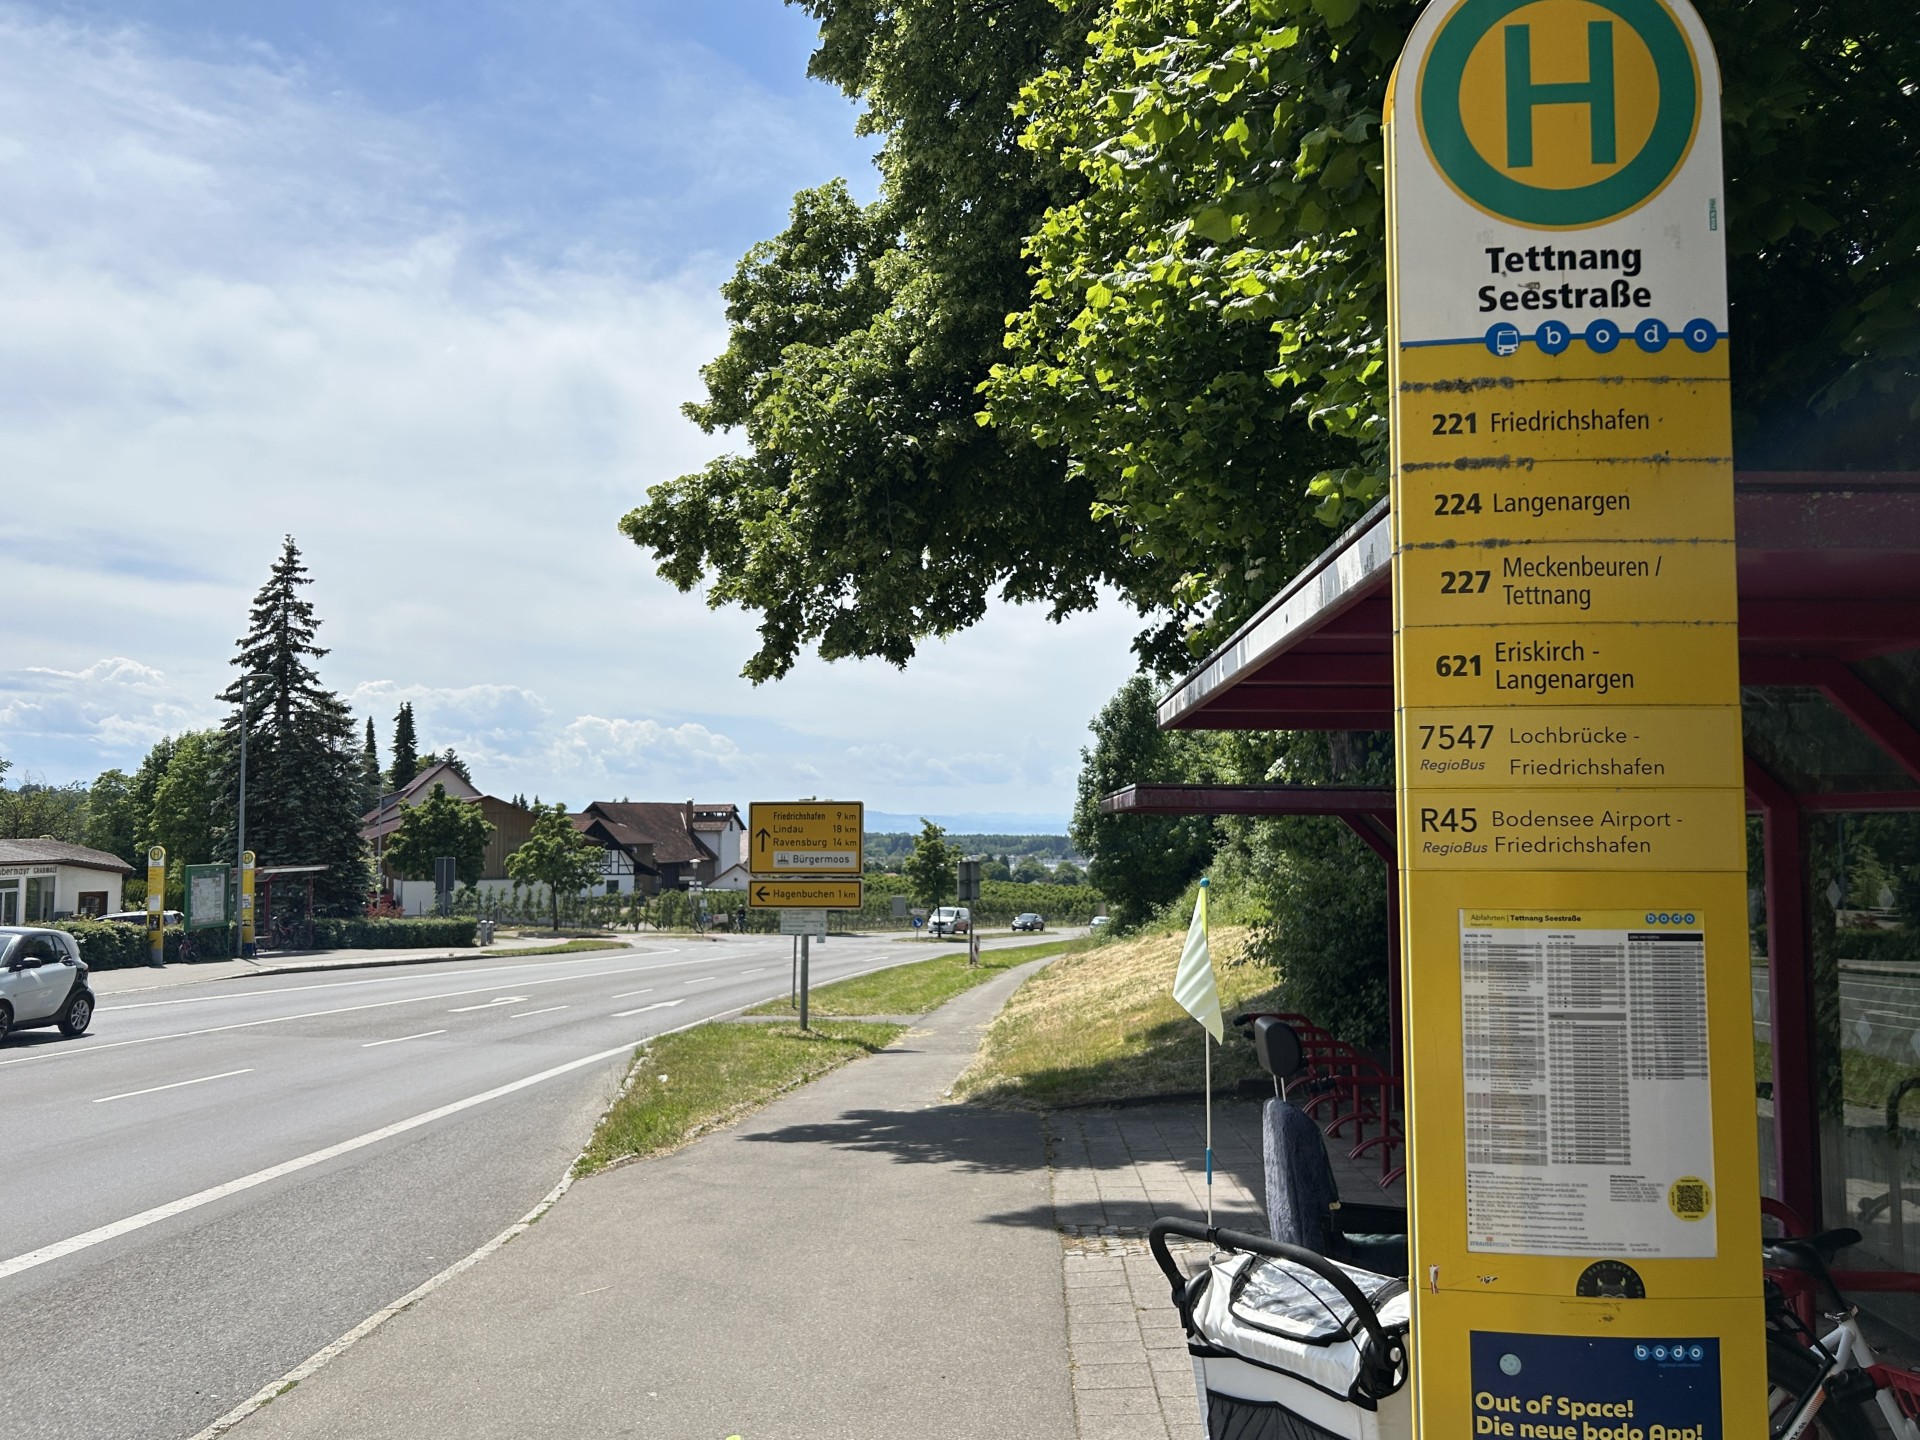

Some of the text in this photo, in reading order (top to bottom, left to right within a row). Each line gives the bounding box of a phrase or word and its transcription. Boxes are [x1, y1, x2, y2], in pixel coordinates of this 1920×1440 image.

[1504, 20, 1617, 168] H
[1485, 245, 1642, 277] Tettnang
[1478, 279, 1652, 313] Seestraße
[1431, 408, 1650, 435] 221 Friedrichshafen
[1434, 491, 1630, 518] 224 Langenargen
[1503, 555, 1649, 578] Meckenbeuren
[1440, 570, 1491, 594] 227
[1503, 584, 1591, 610] Tettnang
[1495, 639, 1585, 662] Eriskirch
[1436, 654, 1482, 677] 621
[1495, 669, 1635, 694] Langenargen
[1418, 724, 1494, 750] 7547
[1509, 726, 1627, 745] Lochbrücke
[1420, 758, 1665, 776] RegioBus Friedrichshafen
[773, 812, 857, 820] Friedrichshafen 9 km
[1421, 807, 1477, 833] R45
[1491, 809, 1594, 828] Bodensee
[1600, 809, 1671, 831] Airport
[773, 824, 857, 834] Lindau 18 km
[773, 838, 857, 848] Ravensburg 14 km
[1422, 836, 1652, 855] RegioBus Friedrichshafen
[792, 854, 850, 866] Bürgermoos
[773, 889, 856, 901] Hagenbuchen 1 km
[1470, 913, 1506, 923] Abfahrten
[1509, 914, 1544, 924] Tettnang
[1544, 914, 1582, 923] Seestraße
[1475, 1391, 1634, 1421] Out of Space!
[1476, 1415, 1514, 1437] Die
[1519, 1422, 1578, 1440] neue
[1583, 1421, 1643, 1440] bodo
